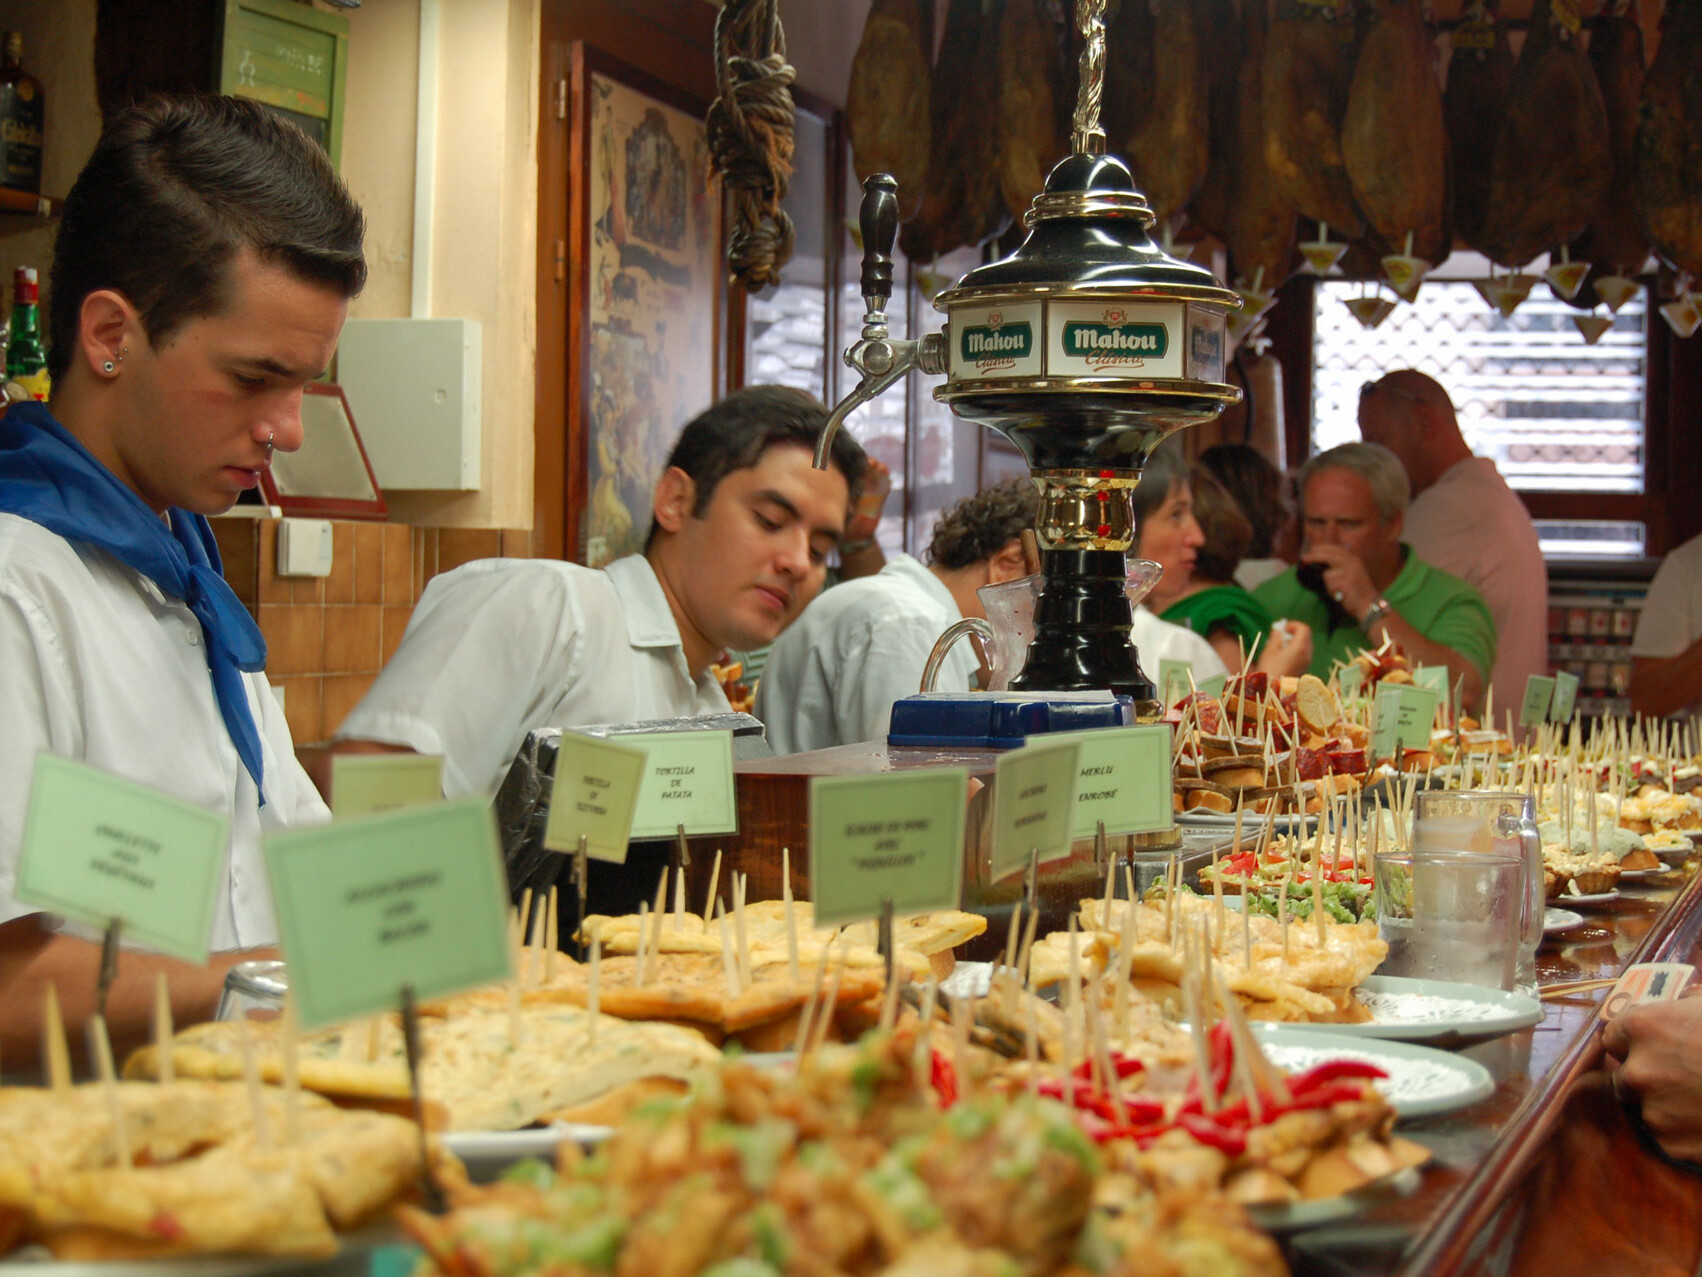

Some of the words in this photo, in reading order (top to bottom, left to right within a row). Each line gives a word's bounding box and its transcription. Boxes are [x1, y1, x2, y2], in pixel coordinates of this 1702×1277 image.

[968, 331, 1025, 353] Mahou
[1073, 329, 1157, 350] Mahou
[655, 766, 695, 776] TORTILLA
[1080, 766, 1114, 777] MERLU
[670, 779, 682, 788] DE
[661, 791, 693, 800] PATATA
